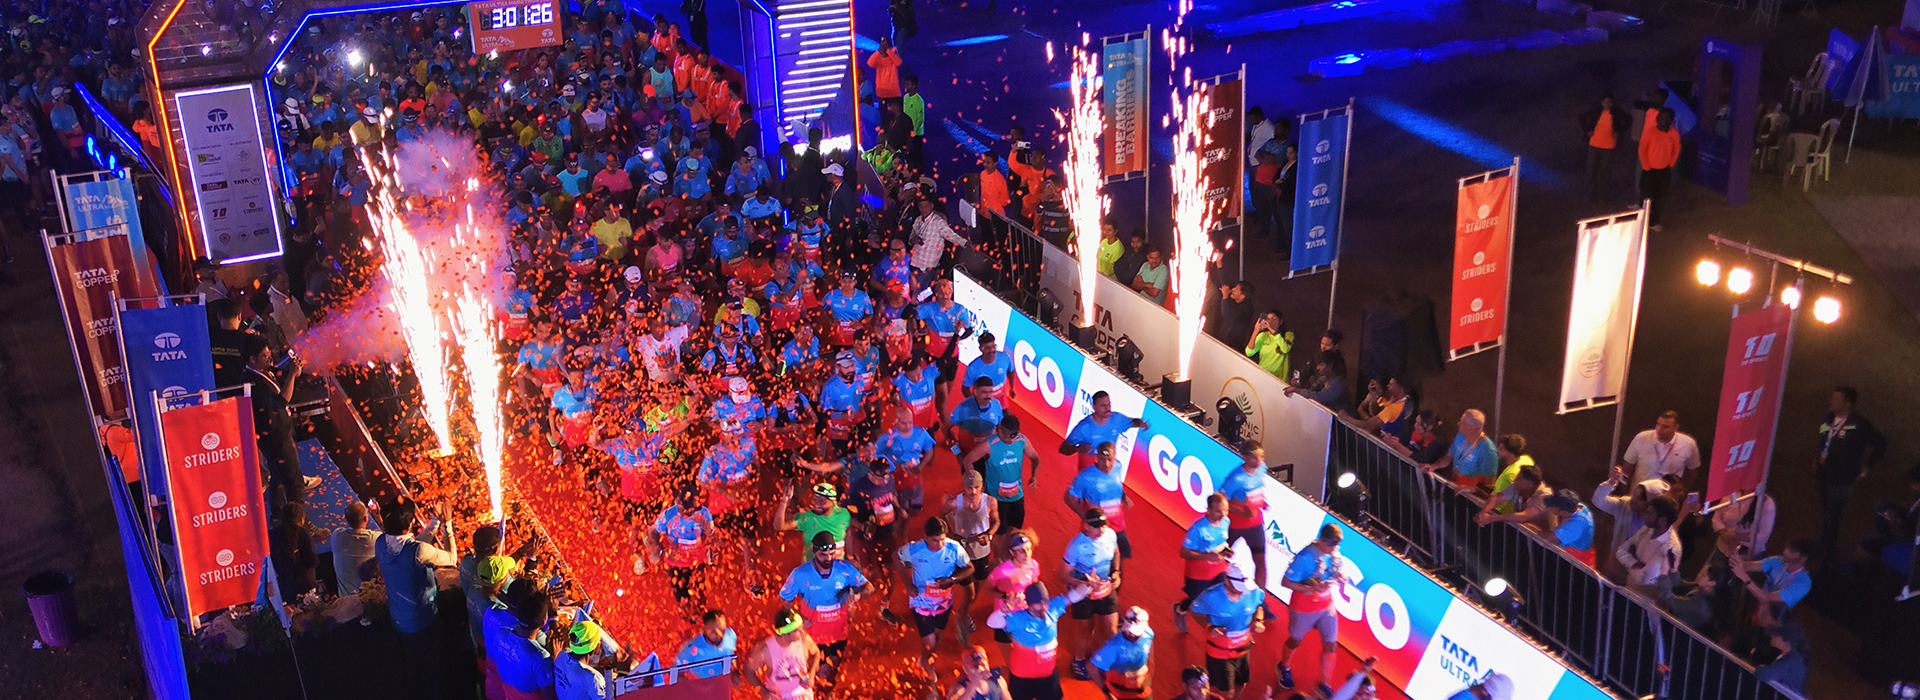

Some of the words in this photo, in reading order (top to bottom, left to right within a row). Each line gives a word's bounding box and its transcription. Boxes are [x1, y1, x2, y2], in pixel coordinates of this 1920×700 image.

[1109, 53, 1126, 61] TATA
[1893, 65, 1920, 78] TA
[1126, 69, 1135, 155] BARRIERS
[1204, 112, 1232, 126] CPPER
[206, 123, 234, 133] TATA
[1115, 78, 1126, 164] BREAKING
[1312, 154, 1331, 164] TATA
[74, 195, 100, 205] TATA
[78, 203, 104, 212] ULTRA
[1308, 197, 1330, 207] TATA
[1465, 215, 1498, 233] STRIDERS
[1305, 238, 1326, 249] TATA
[74, 268, 107, 279] TATA
[1461, 262, 1496, 280] STRIDERS
[76, 272, 118, 289] COPPER
[1073, 290, 1113, 332] TTA
[1459, 308, 1495, 326] STRIDERS
[88, 325, 115, 339] COPP
[152, 350, 187, 361] TATA
[99, 366, 124, 378] TAT
[101, 374, 125, 387] COPP
[1014, 339, 1065, 408] GO
[1080, 388, 1093, 406] TA
[184, 446, 240, 468] STRIDERS
[1148, 434, 1214, 513] GO
[193, 504, 247, 528] STRIDERS
[200, 562, 255, 585] STRIDERS
[1331, 555, 1410, 650] GO
[1440, 634, 1478, 673] TATA
